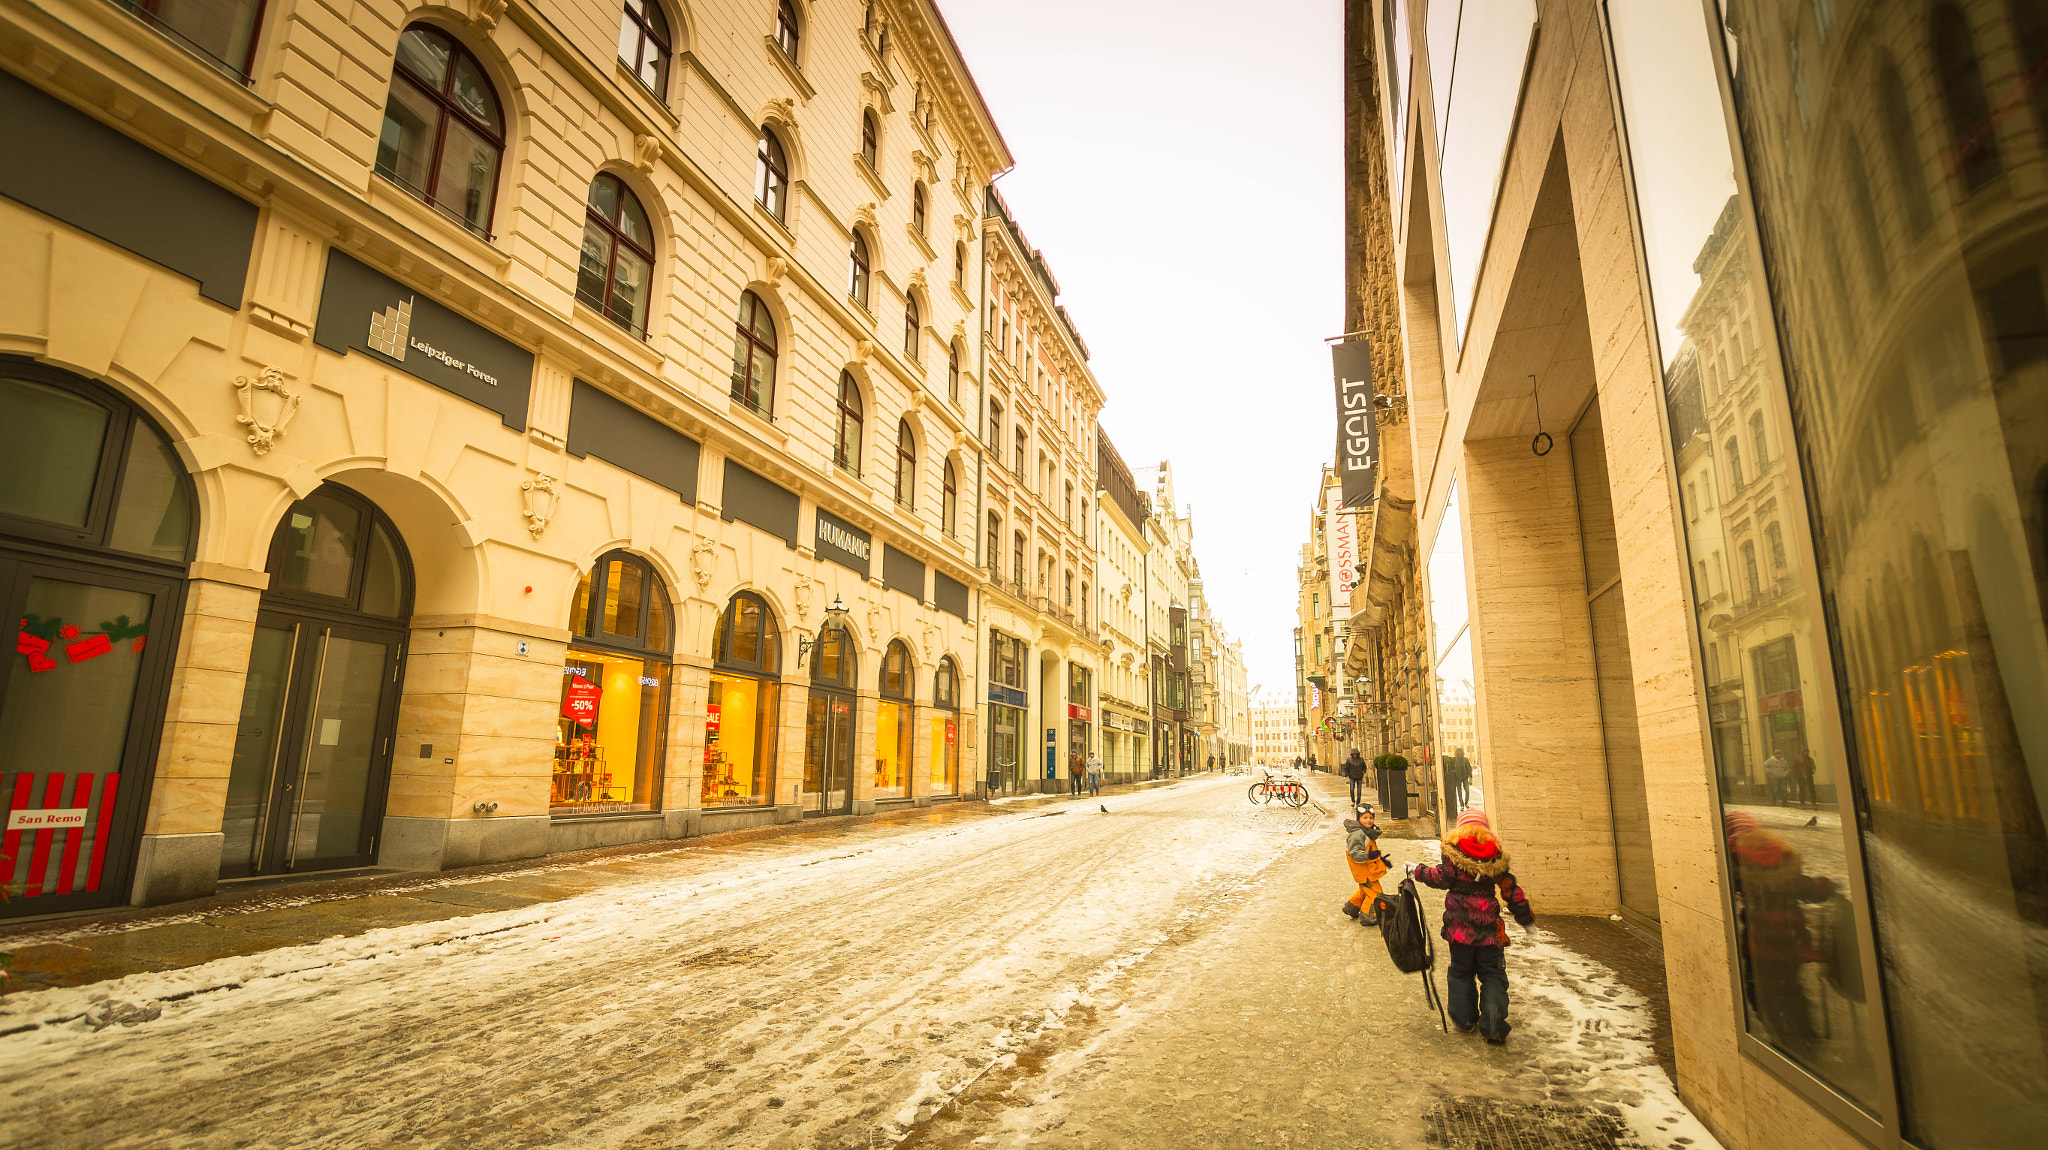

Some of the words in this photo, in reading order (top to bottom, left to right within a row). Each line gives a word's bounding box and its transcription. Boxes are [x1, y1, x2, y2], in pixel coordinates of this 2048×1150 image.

[410, 336, 465, 370] Leipziger
[466, 363, 498, 386] Foren
[1341, 377, 1371, 472] EGOIST
[818, 518, 870, 561] HUMANIC
[1333, 499, 1353, 593] ROSSMANN
[571, 700, 593, 711] -50%
[706, 712, 720, 723] SALE
[16, 814, 43, 824] San
[46, 814, 83, 823] Remo
